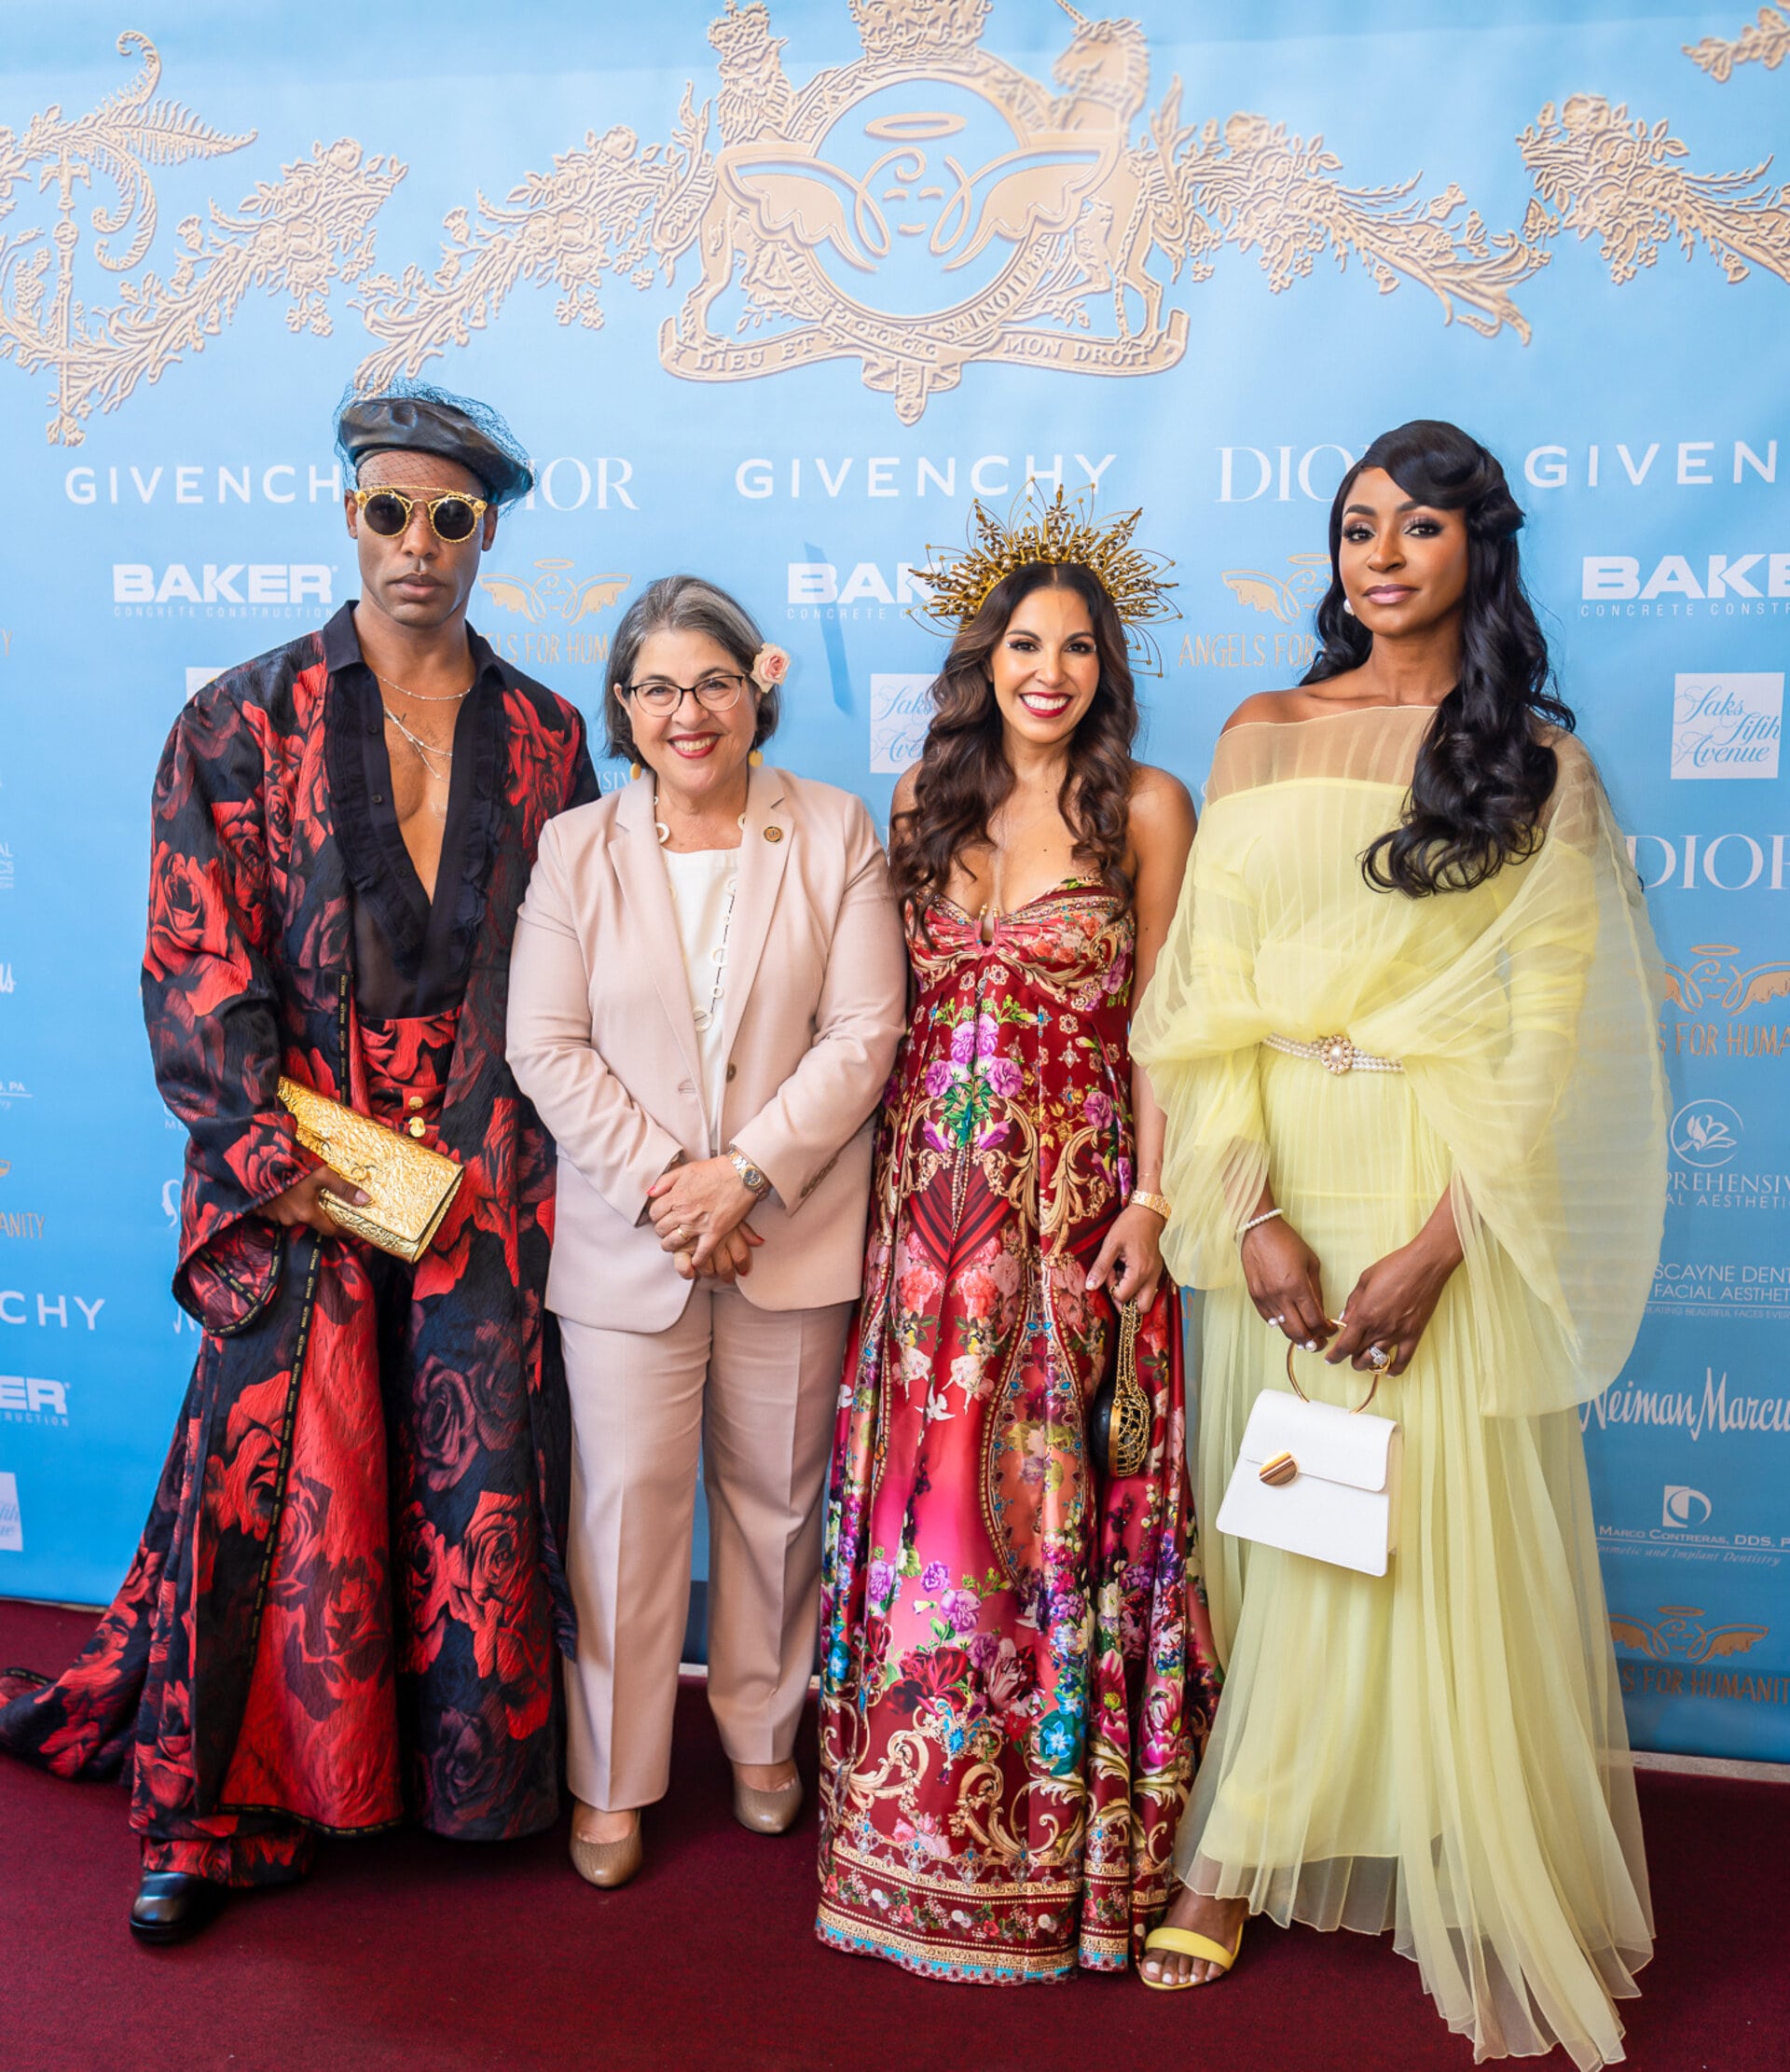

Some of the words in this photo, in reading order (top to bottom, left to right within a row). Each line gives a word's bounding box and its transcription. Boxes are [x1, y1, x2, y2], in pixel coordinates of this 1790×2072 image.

[735, 454, 1118, 498] GIVENCHY
[1212, 443, 1369, 504] DIO
[1523, 439, 1778, 489] GIVEN
[64, 464, 340, 504] GIVENCH
[520, 456, 641, 512] IOR
[112, 563, 333, 604] BAKER
[114, 605, 203, 618] CONCRETE
[786, 606, 896, 621] CONCRETE
[1580, 604, 1694, 618] CONCRETE
[523, 632, 561, 665] FOR
[1177, 632, 1266, 670] ANGELS
[1274, 632, 1315, 670] FOR
[1672, 731, 1770, 768] Avenue
[1674, 1022, 1717, 1057] FOR
[1697, 1194, 1790, 1209] AESTHETI
[1654, 1282, 1715, 1300] FACIAL
[1580, 1381, 1695, 1433] Neiman
[1596, 1544, 1641, 1555] osmetic
[1672, 1549, 1719, 1562] Implant
[1723, 1552, 1781, 1568] Dentistry
[1642, 1666, 1682, 1695] FOR
